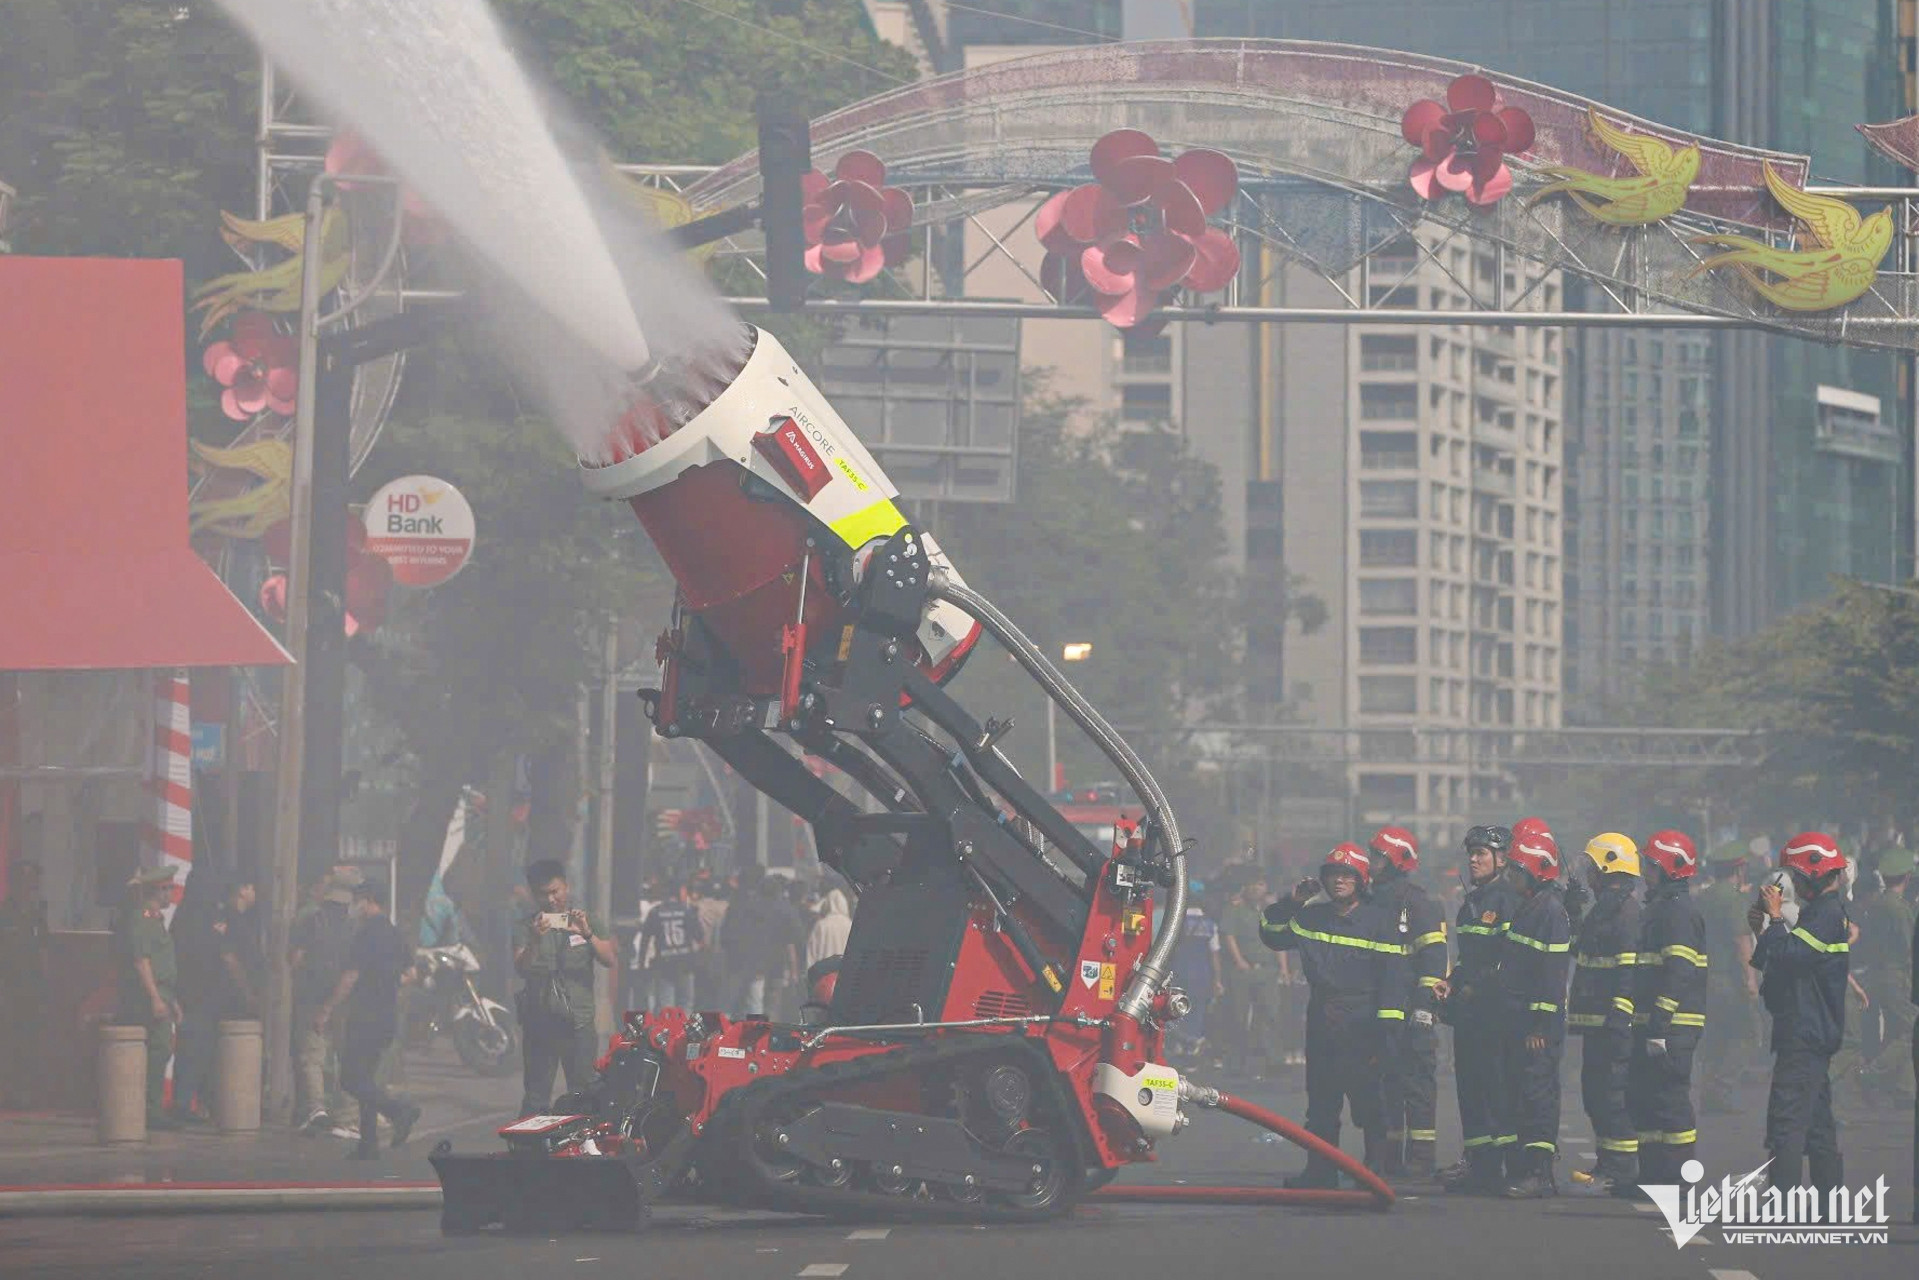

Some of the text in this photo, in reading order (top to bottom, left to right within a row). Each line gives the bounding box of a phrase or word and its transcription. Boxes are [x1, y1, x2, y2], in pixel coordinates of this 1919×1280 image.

[789, 406, 835, 456] AIRCORE
[793, 442, 815, 470] MAGIRUS
[839, 459, 867, 490] TAF35-C
[387, 494, 421, 513] HD
[387, 514, 443, 534] Bank
